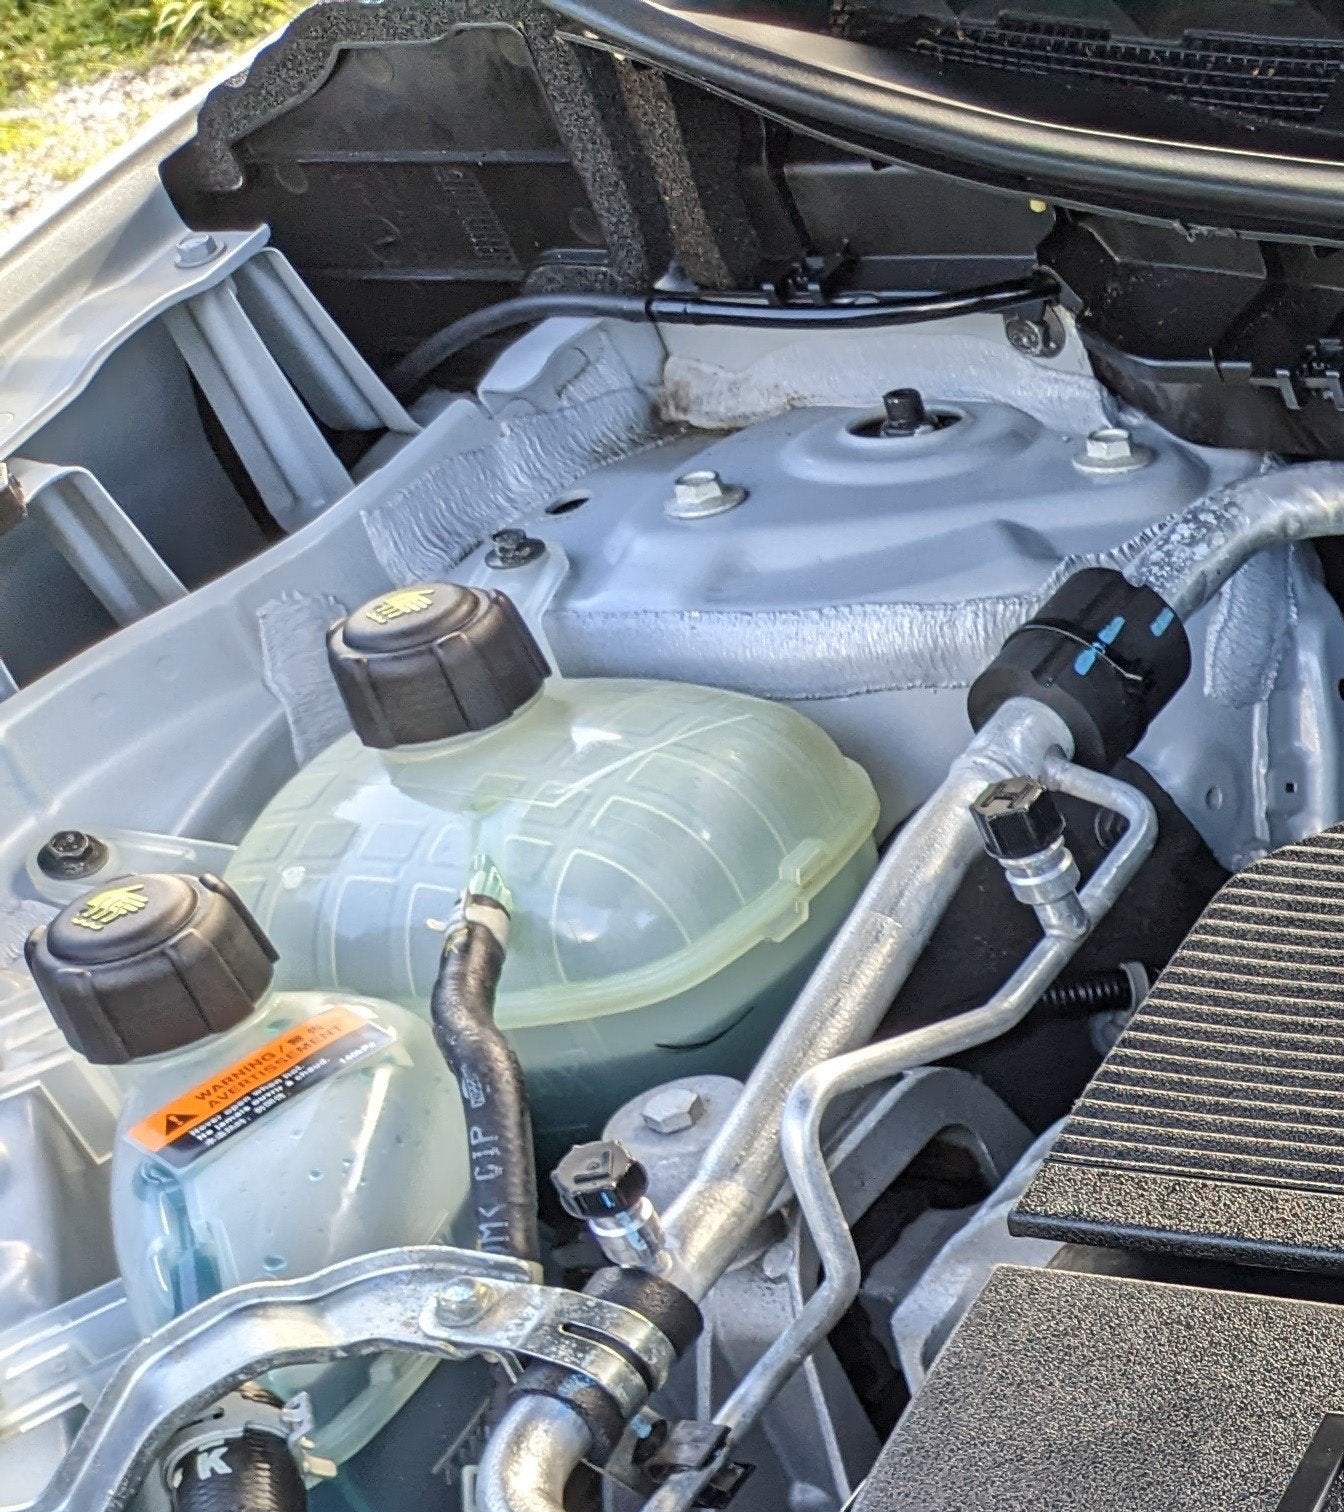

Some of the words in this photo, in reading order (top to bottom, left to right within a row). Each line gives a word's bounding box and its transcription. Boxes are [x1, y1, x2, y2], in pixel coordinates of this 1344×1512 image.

[196, 1051, 276, 1100] WARNING
[208, 1024, 342, 1109] AVERTISSEMENT
[196, 1446, 233, 1481] K
